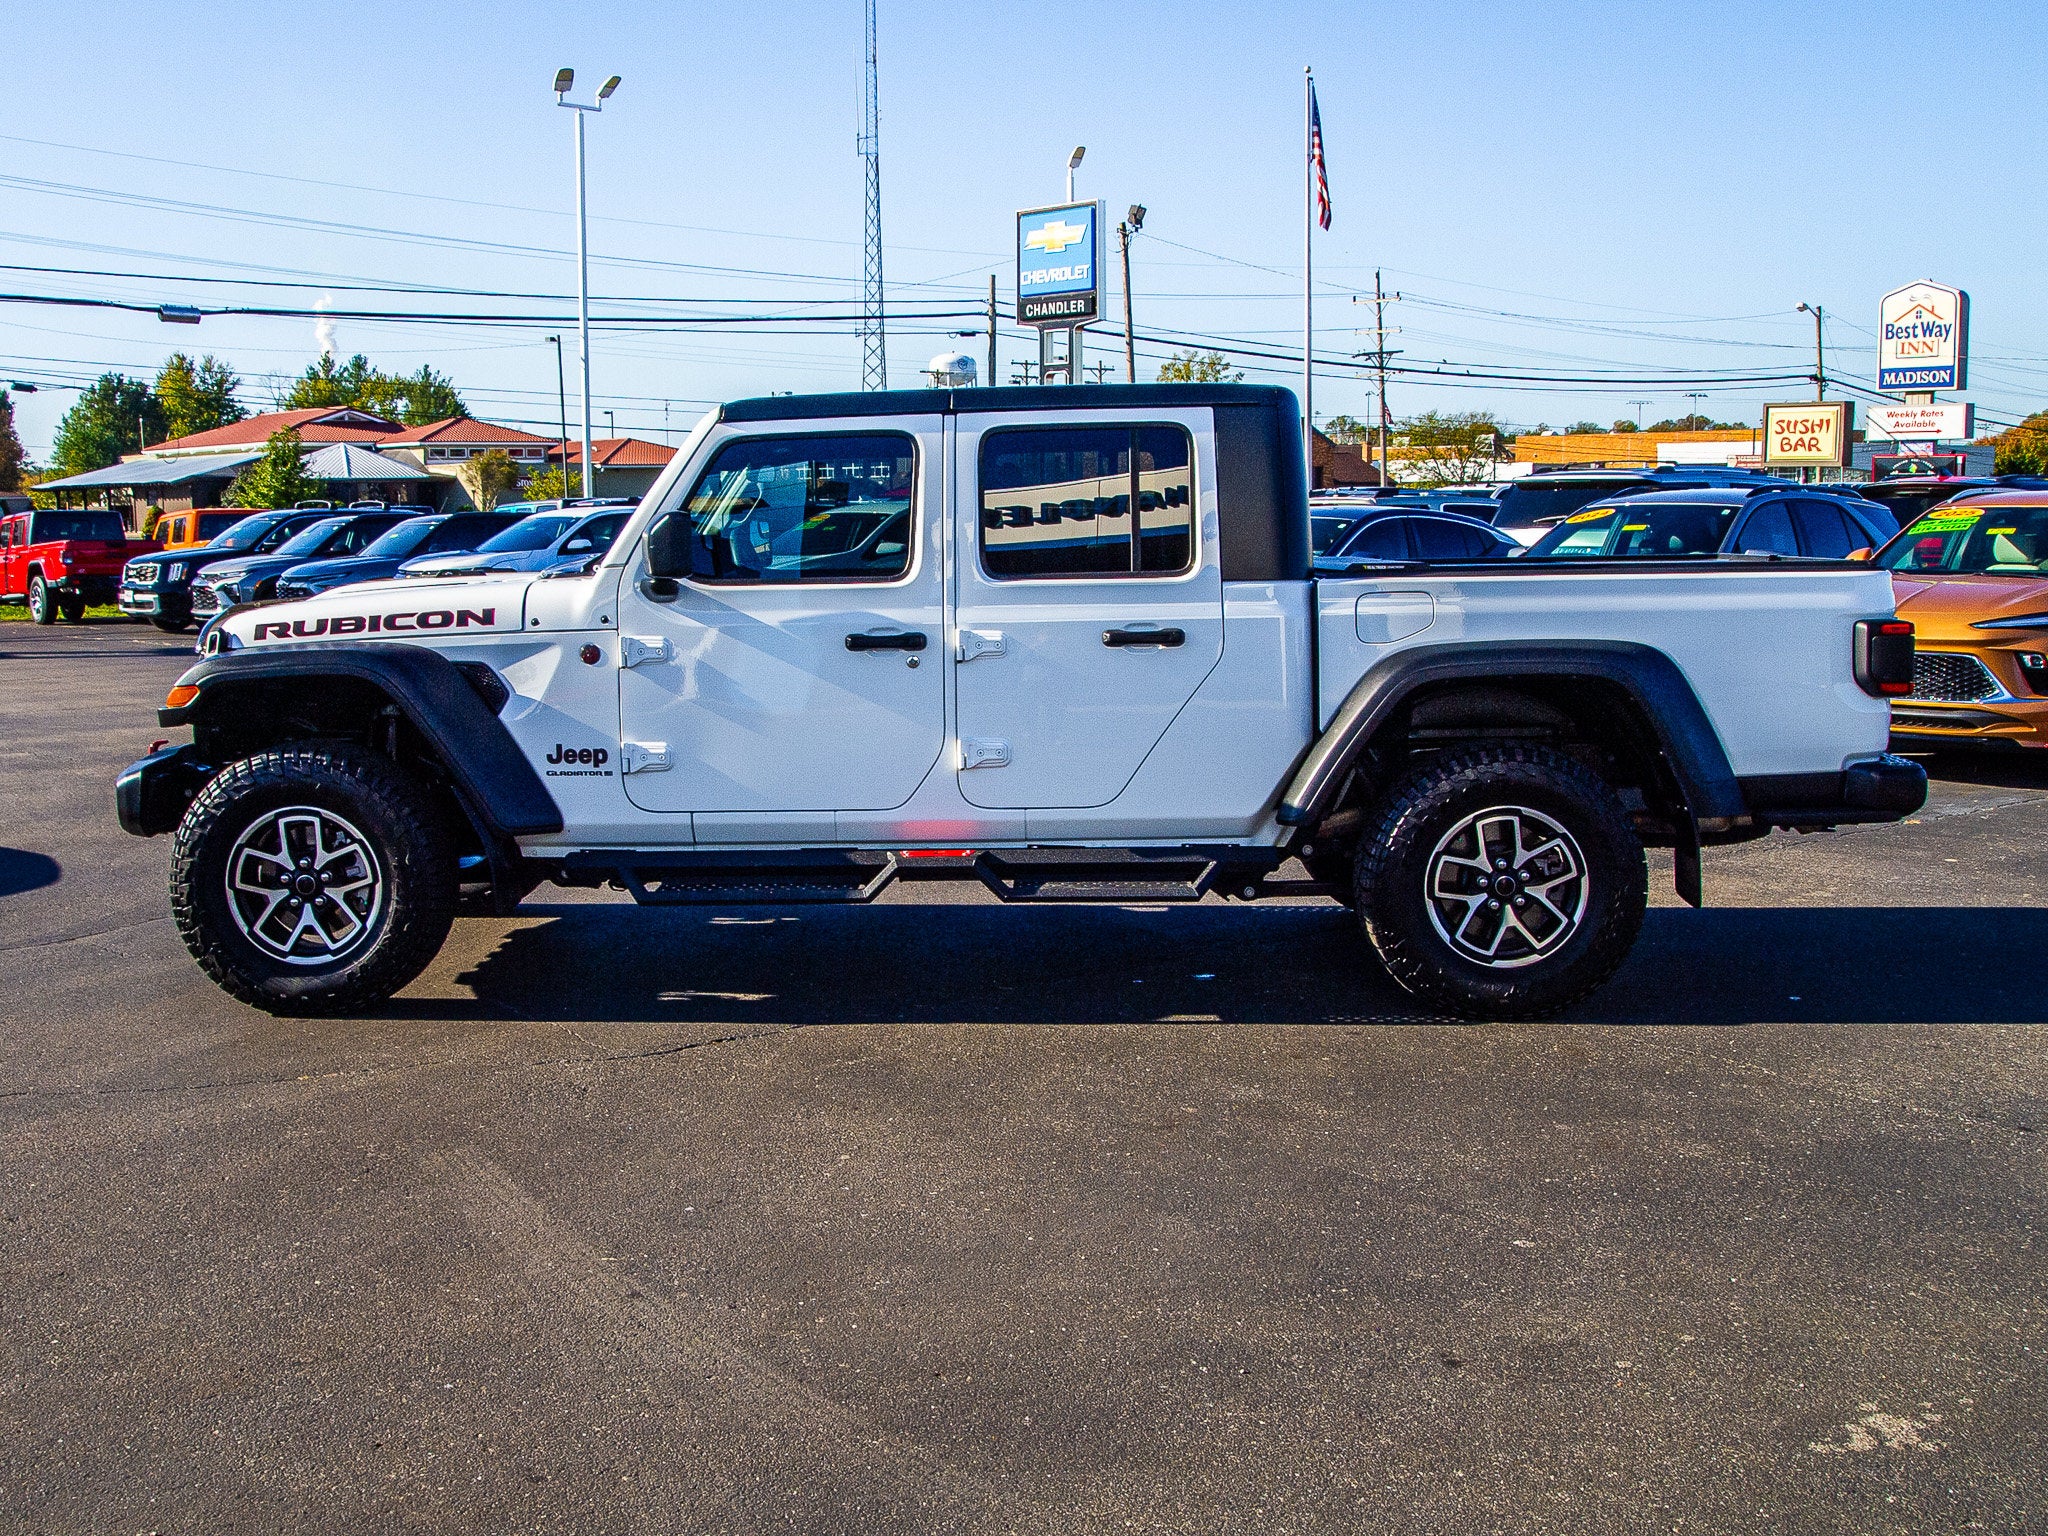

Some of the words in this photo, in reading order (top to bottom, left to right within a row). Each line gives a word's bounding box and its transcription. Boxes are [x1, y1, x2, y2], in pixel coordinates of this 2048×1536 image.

[1020, 264, 1090, 285] CHEVROLET
[1026, 300, 1085, 316] CHANDLER
[1885, 323, 1918, 340] Best
[1920, 321, 1952, 343] Way
[1900, 341, 1935, 354] INN
[1882, 370, 1951, 385] MADISON
[1887, 411, 1917, 419] Weekly
[1775, 418, 1830, 434] SUSHI
[1893, 420, 1936, 428] Available
[1780, 437, 1822, 452] BAR
[254, 608, 495, 641] RUBICON
[546, 744, 608, 768] Jeep
